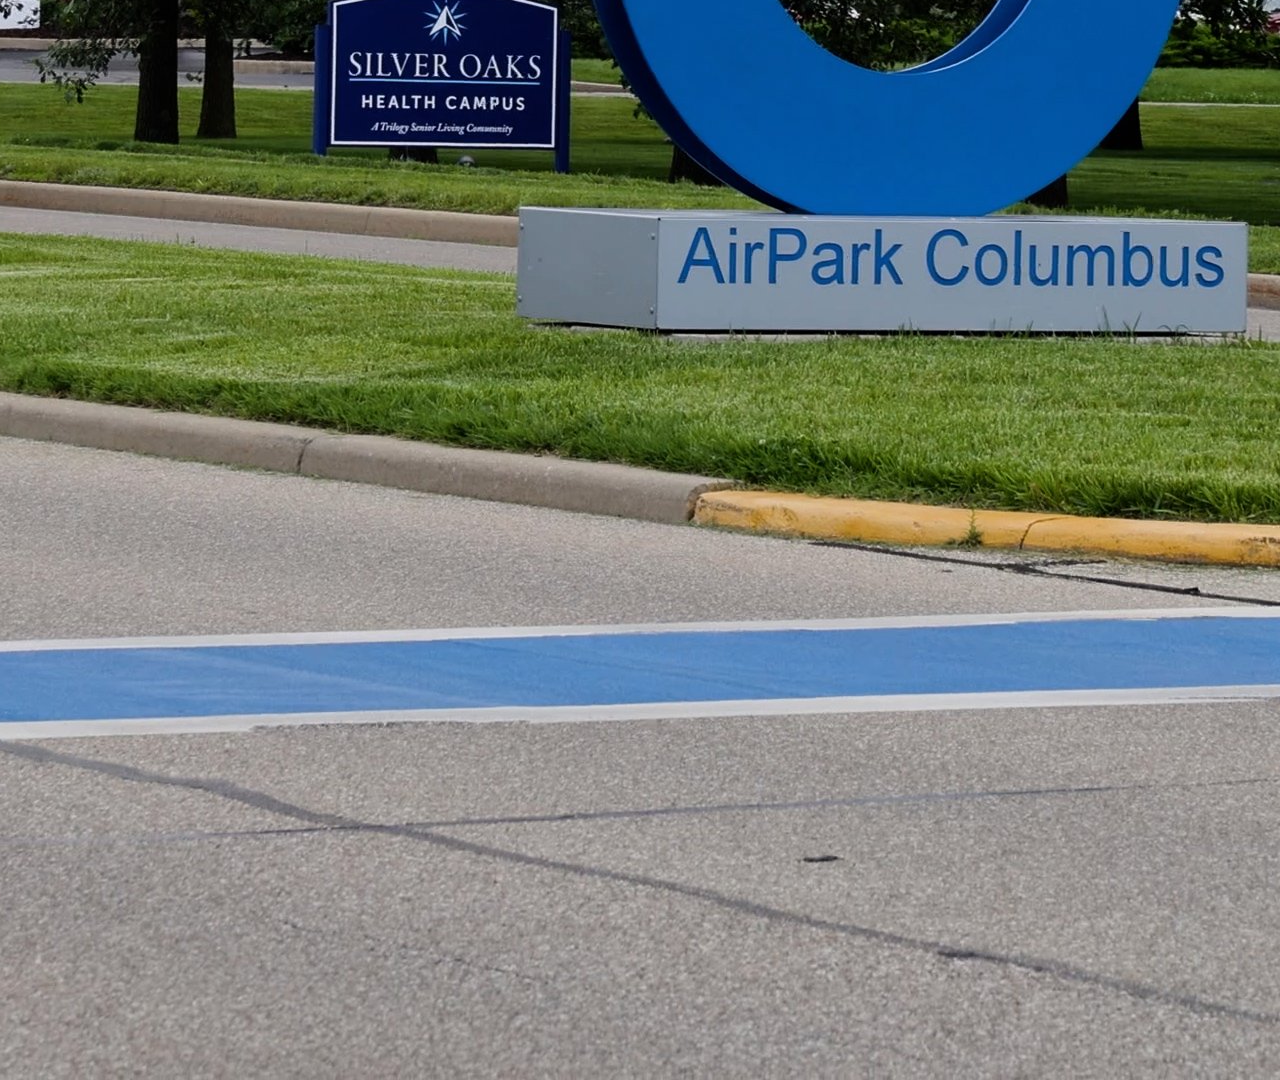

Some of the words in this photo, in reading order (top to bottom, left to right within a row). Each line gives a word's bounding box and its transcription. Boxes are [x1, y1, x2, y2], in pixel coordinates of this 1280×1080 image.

[349, 51, 451, 78] SILVER
[460, 53, 542, 80] OAKS
[361, 94, 436, 109] HEALTH
[445, 95, 526, 111] CAMPUS
[370, 122, 379, 131] A
[380, 122, 409, 135] Trilogy
[410, 123, 436, 132] Senior
[437, 123, 465, 135] Living
[466, 123, 513, 136] Community
[677, 226, 904, 287] AirPark
[925, 229, 1225, 290] Columbus
